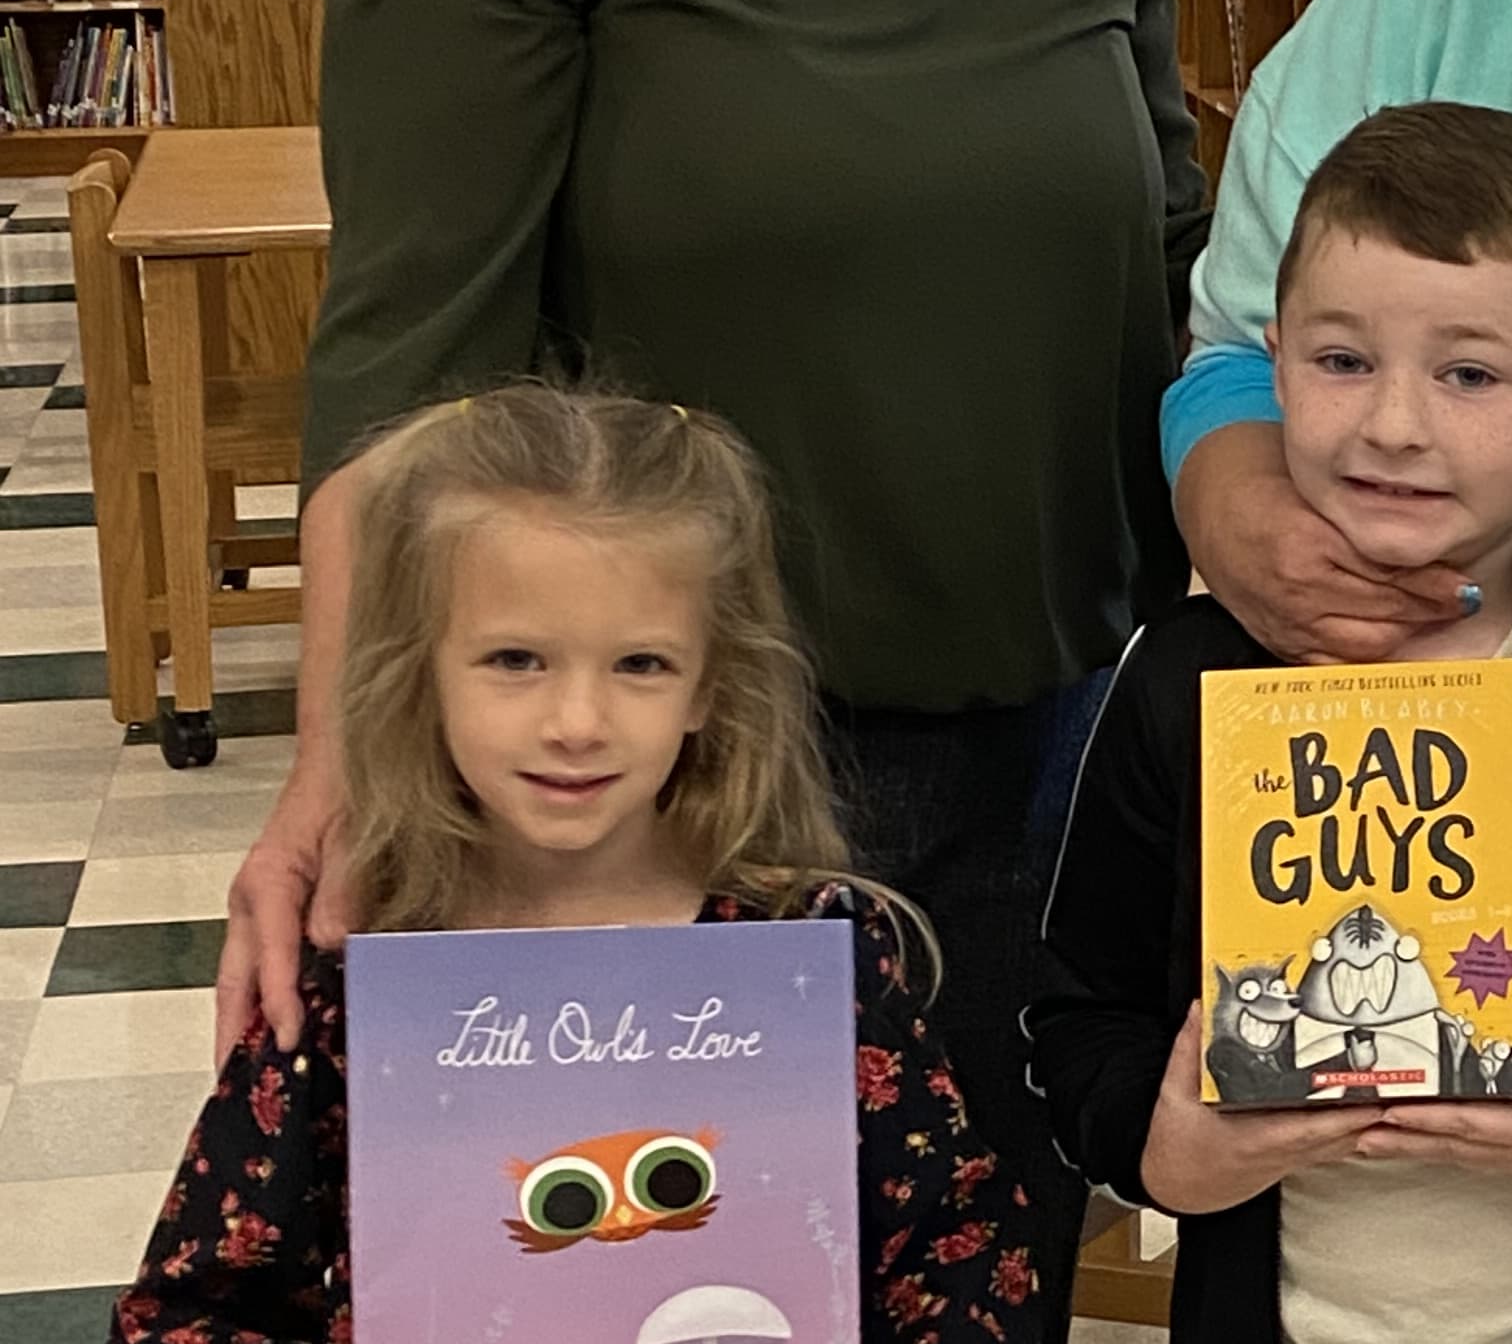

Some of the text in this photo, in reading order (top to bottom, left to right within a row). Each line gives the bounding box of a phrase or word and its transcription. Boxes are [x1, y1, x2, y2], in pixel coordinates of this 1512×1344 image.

[1254, 681, 1280, 695] NEW
[1358, 674, 1437, 692] BESTSELLING
[1270, 701, 1348, 725] AARON
[1253, 726, 1468, 818] the BAD
[1250, 805, 1475, 906] GUYS
[437, 996, 763, 1067] Little Owl's Love
[1329, 1070, 1423, 1084] SCHOLASTIC
